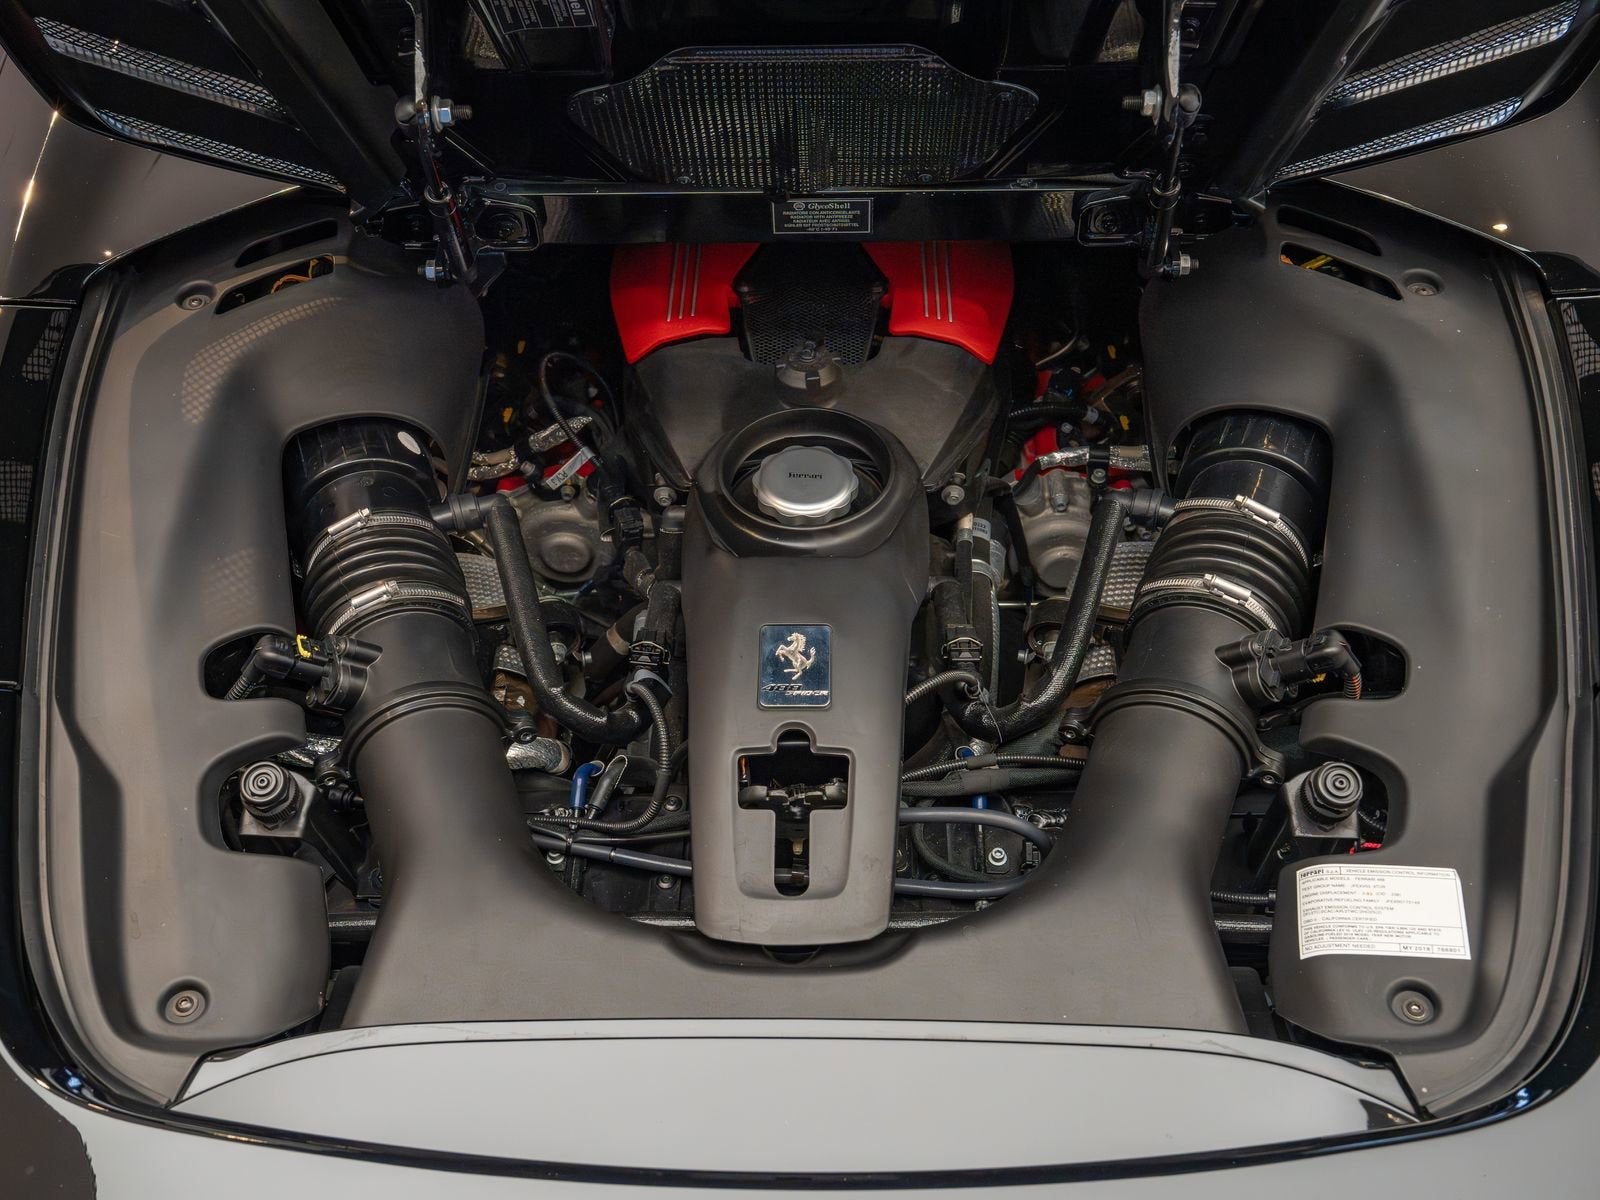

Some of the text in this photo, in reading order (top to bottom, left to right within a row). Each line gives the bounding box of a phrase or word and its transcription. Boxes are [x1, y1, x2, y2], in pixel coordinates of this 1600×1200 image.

[808, 202, 850, 210] GlycoShell
[760, 684, 802, 692] 488
[1300, 869, 1324, 878] Ferrari
